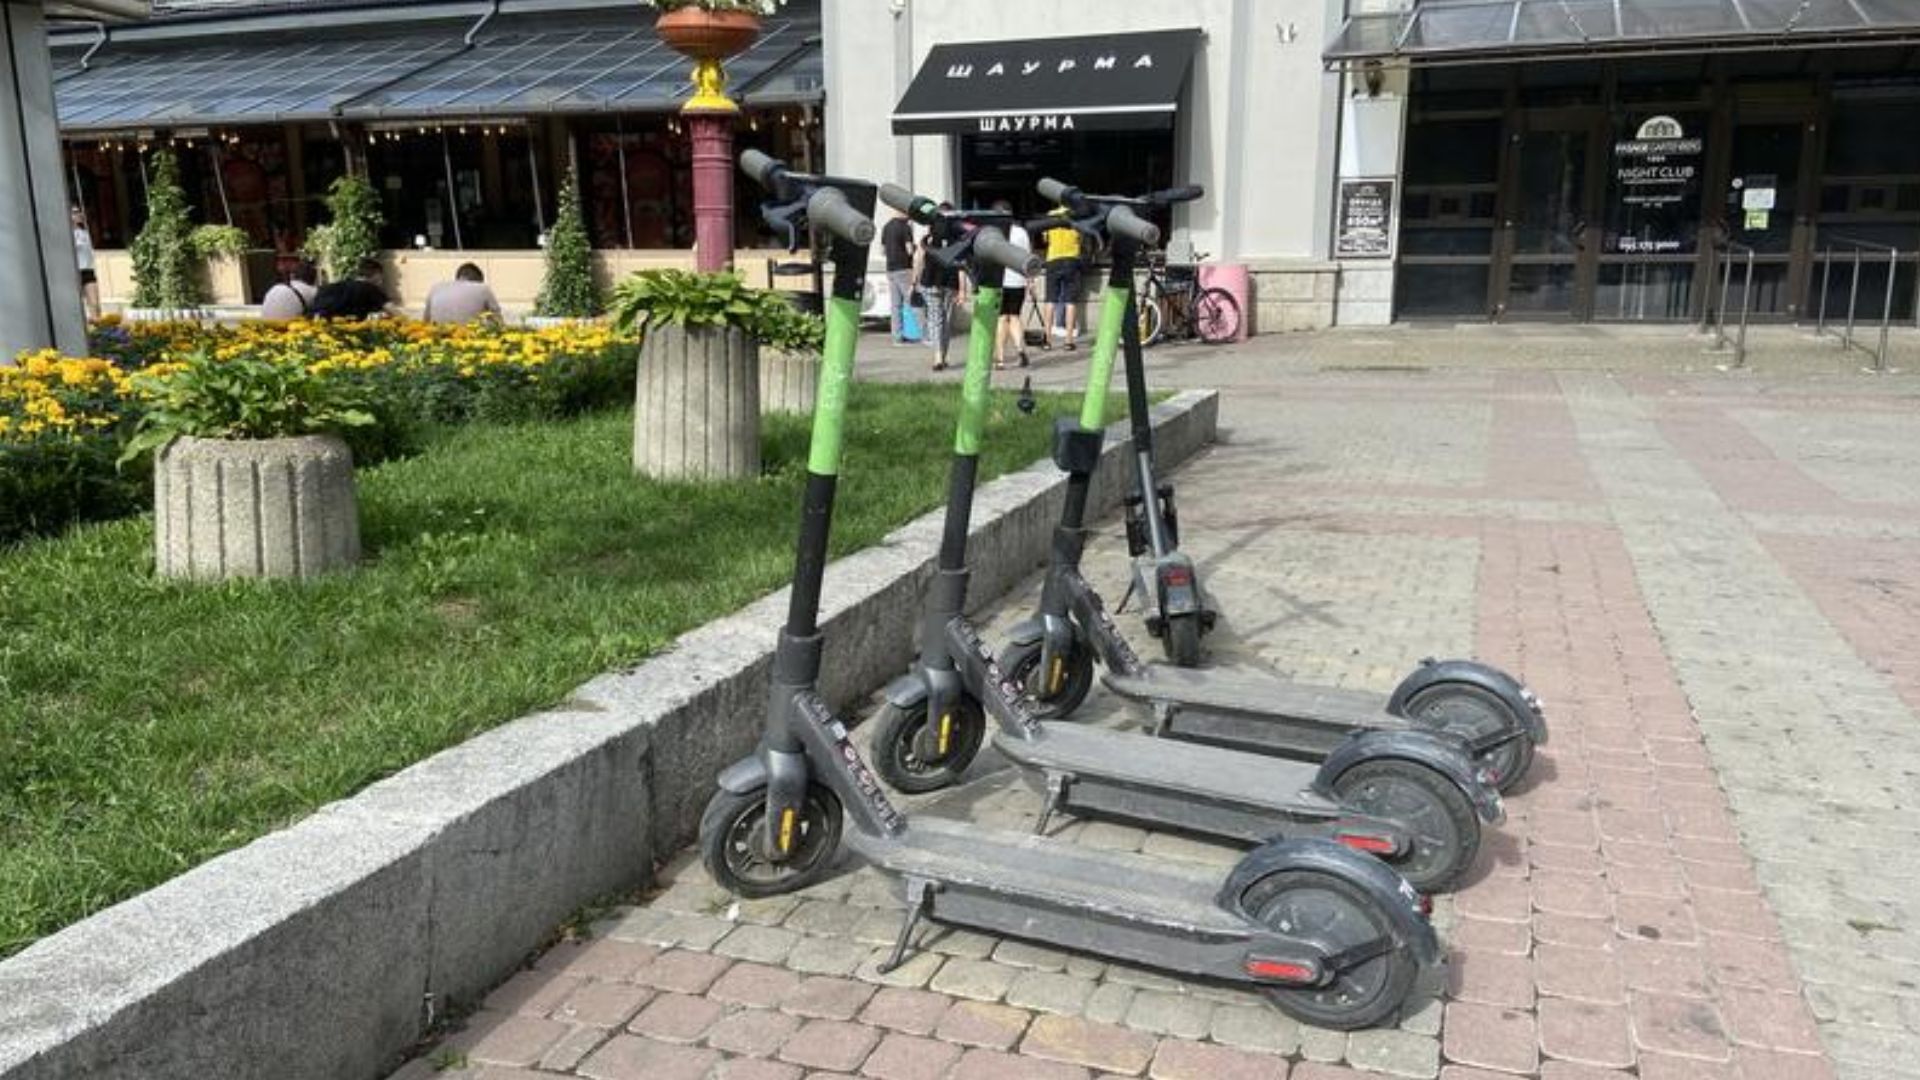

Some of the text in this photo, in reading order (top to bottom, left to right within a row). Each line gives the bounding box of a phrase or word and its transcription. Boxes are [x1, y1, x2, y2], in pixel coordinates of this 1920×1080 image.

[947, 55, 1152, 78] ШАУРМА
[979, 115, 1075, 132] ШАУРМА
[1618, 166, 1694, 179] NIGHT CLUB
